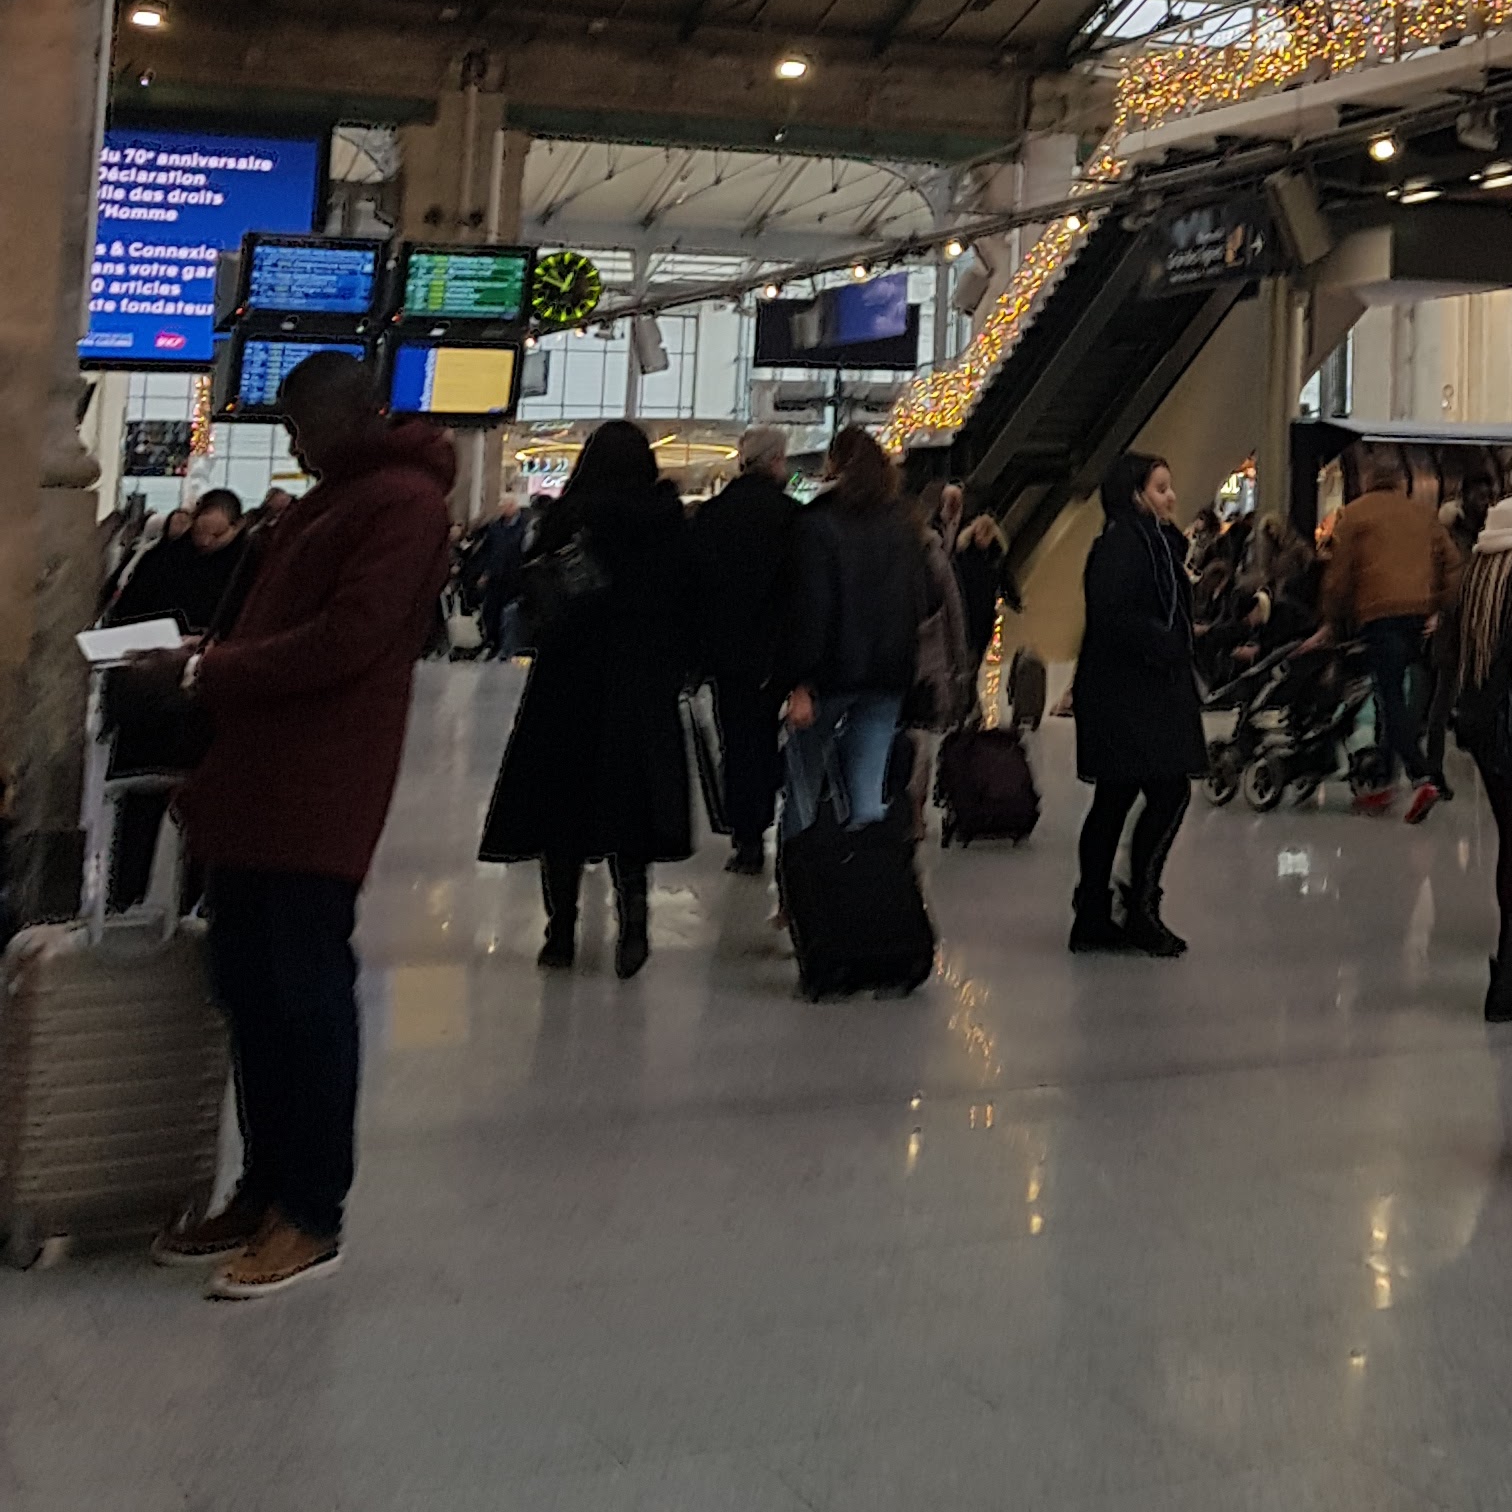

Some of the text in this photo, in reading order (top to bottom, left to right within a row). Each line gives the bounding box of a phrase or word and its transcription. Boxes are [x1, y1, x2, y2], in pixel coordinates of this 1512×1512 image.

[156, 151, 273, 172] anniversaire
[128, 186, 165, 203] des
[166, 188, 224, 206] droits
[128, 262, 179, 279] votre
[108, 279, 182, 297] articles
